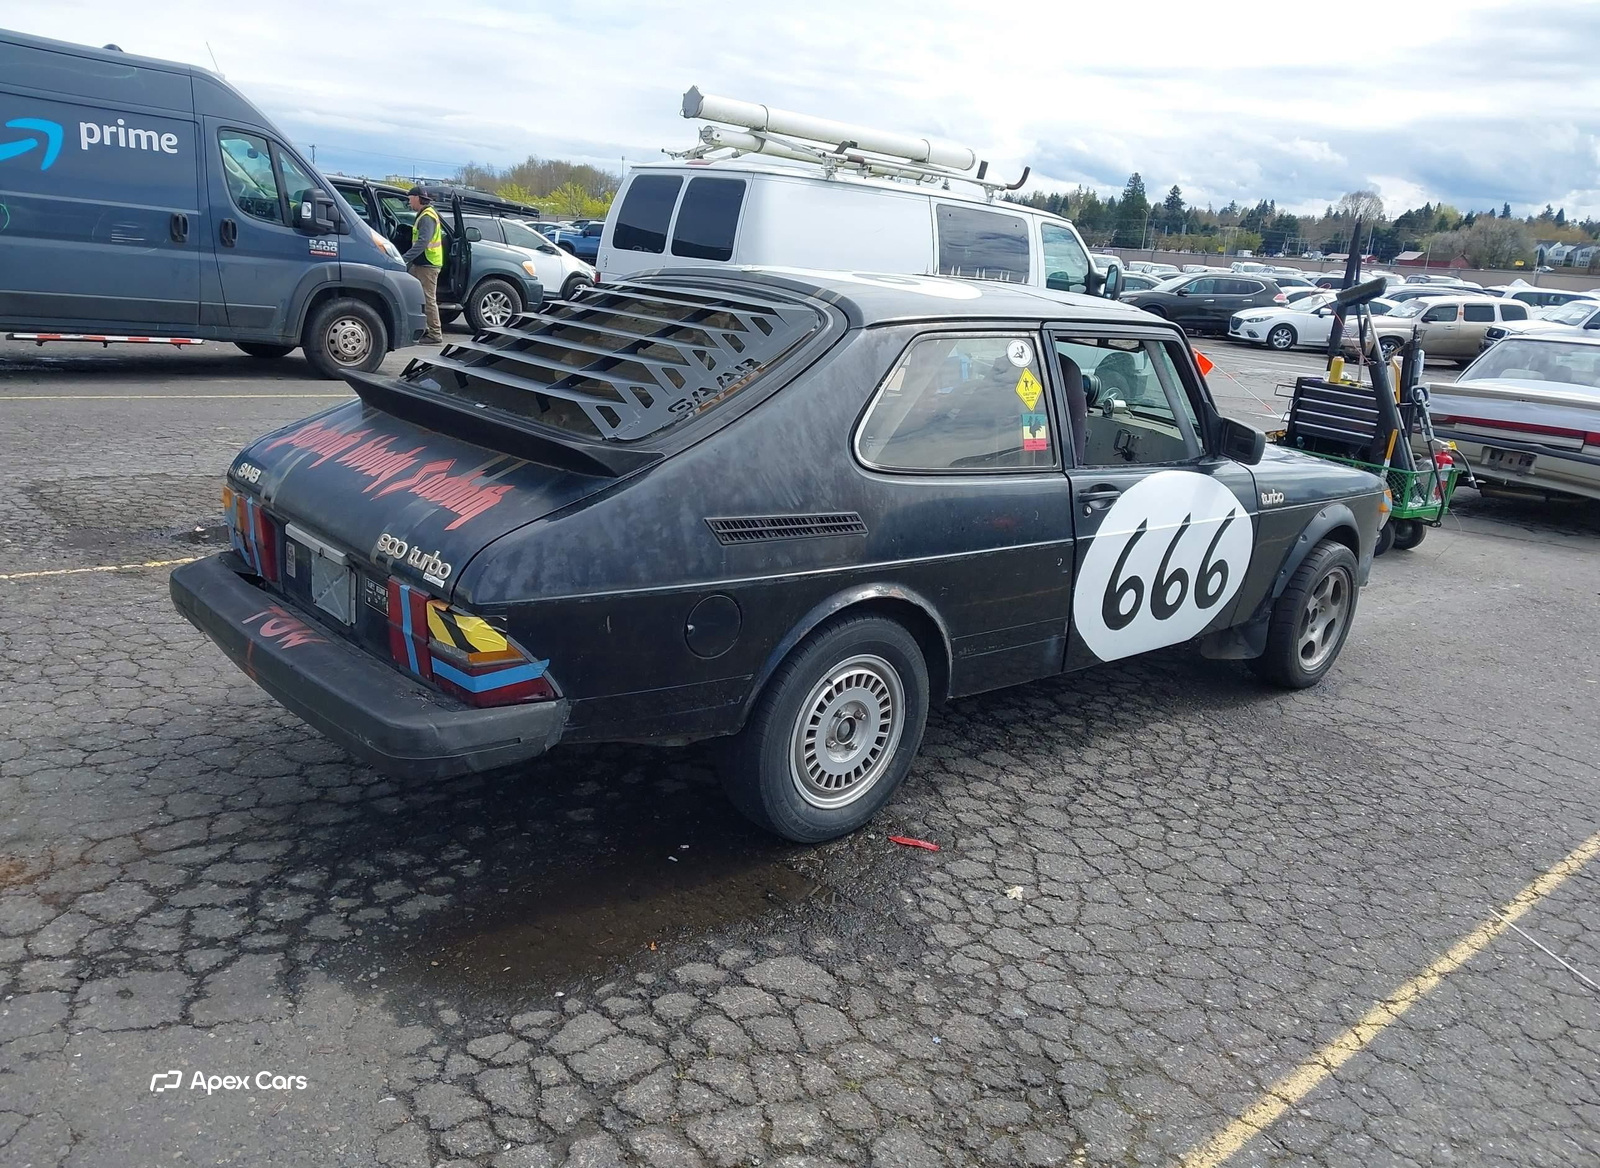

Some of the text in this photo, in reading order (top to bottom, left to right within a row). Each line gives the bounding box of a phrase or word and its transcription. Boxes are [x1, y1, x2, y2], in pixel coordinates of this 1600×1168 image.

[79, 118, 178, 154] prime
[308, 239, 338, 247] RAM
[238, 463, 261, 484] SAAB
[370, 458, 515, 530] Sabbath
[1261, 489, 1285, 505] turbo
[377, 533, 408, 560] 900
[407, 546, 452, 580] turbo
[1102, 507, 1236, 632] 666
[241, 605, 330, 650] TOW
